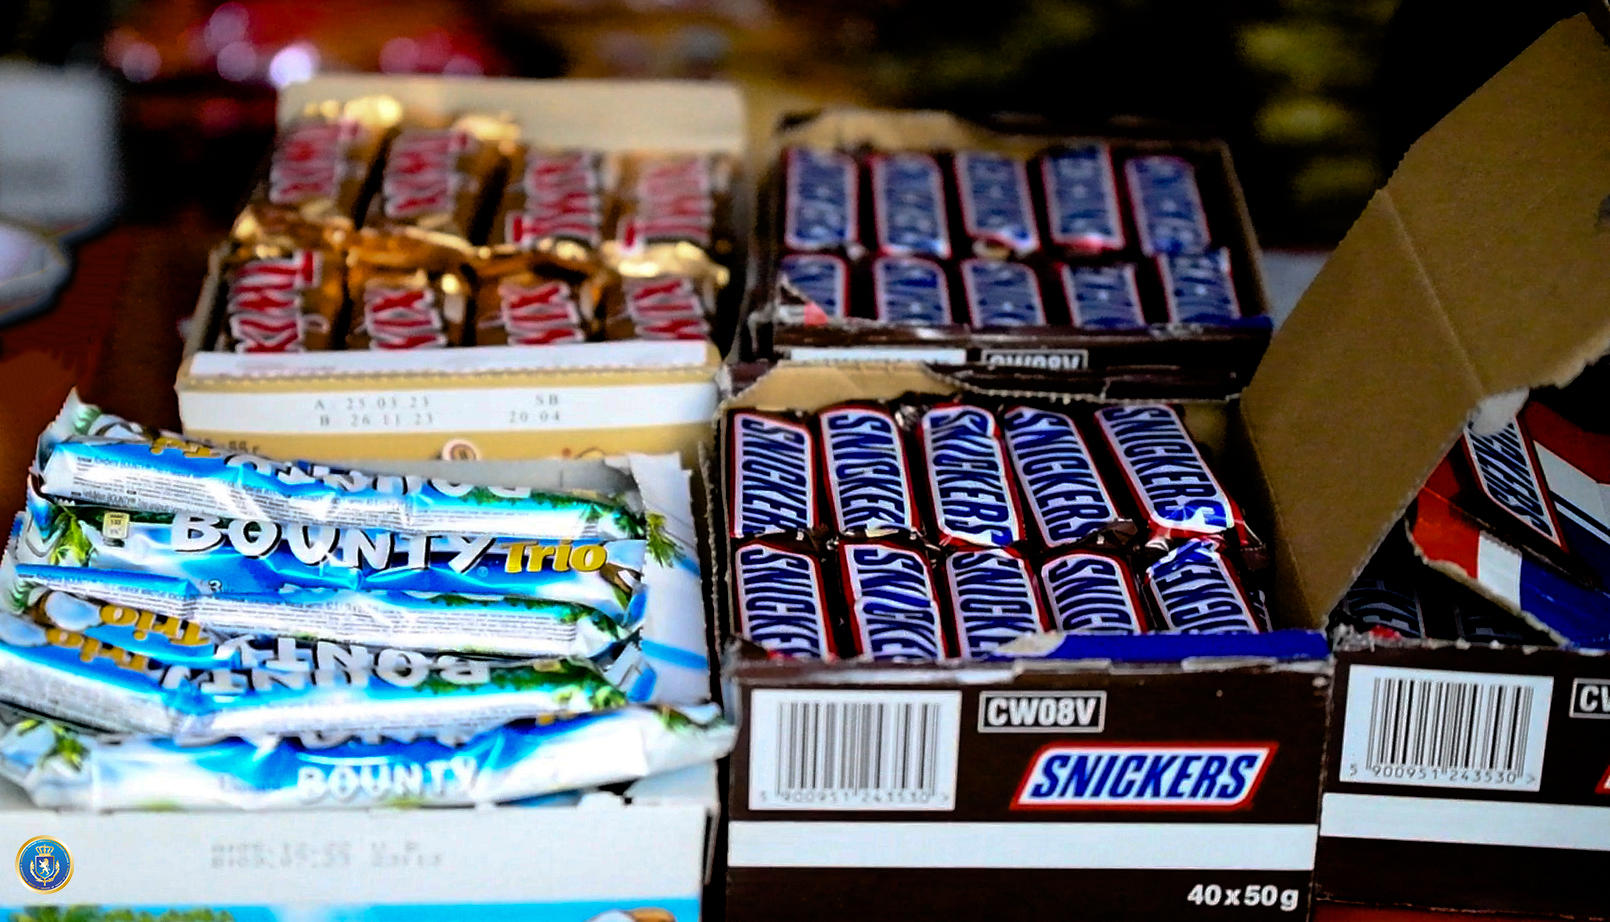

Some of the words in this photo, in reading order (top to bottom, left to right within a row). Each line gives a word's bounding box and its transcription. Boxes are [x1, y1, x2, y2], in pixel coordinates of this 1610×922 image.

[827, 415, 906, 531] SNICKER
[930, 410, 1013, 545] SNICKERS
[1102, 407, 1228, 528] SNICKERS
[171, 510, 498, 574] BOUNTY
[500, 538, 608, 574] Trio
[1048, 558, 1133, 632] SNIC
[741, 548, 821, 660] SNICKE
[853, 548, 938, 660] SNICKE
[952, 552, 1037, 658] SNICKE
[986, 697, 1097, 727] CW08V
[1029, 753, 1262, 800] SNICKERS
[1349, 764, 1358, 777] 5
[1373, 765, 1439, 780] 900951
[1449, 769, 1517, 785] 243530
